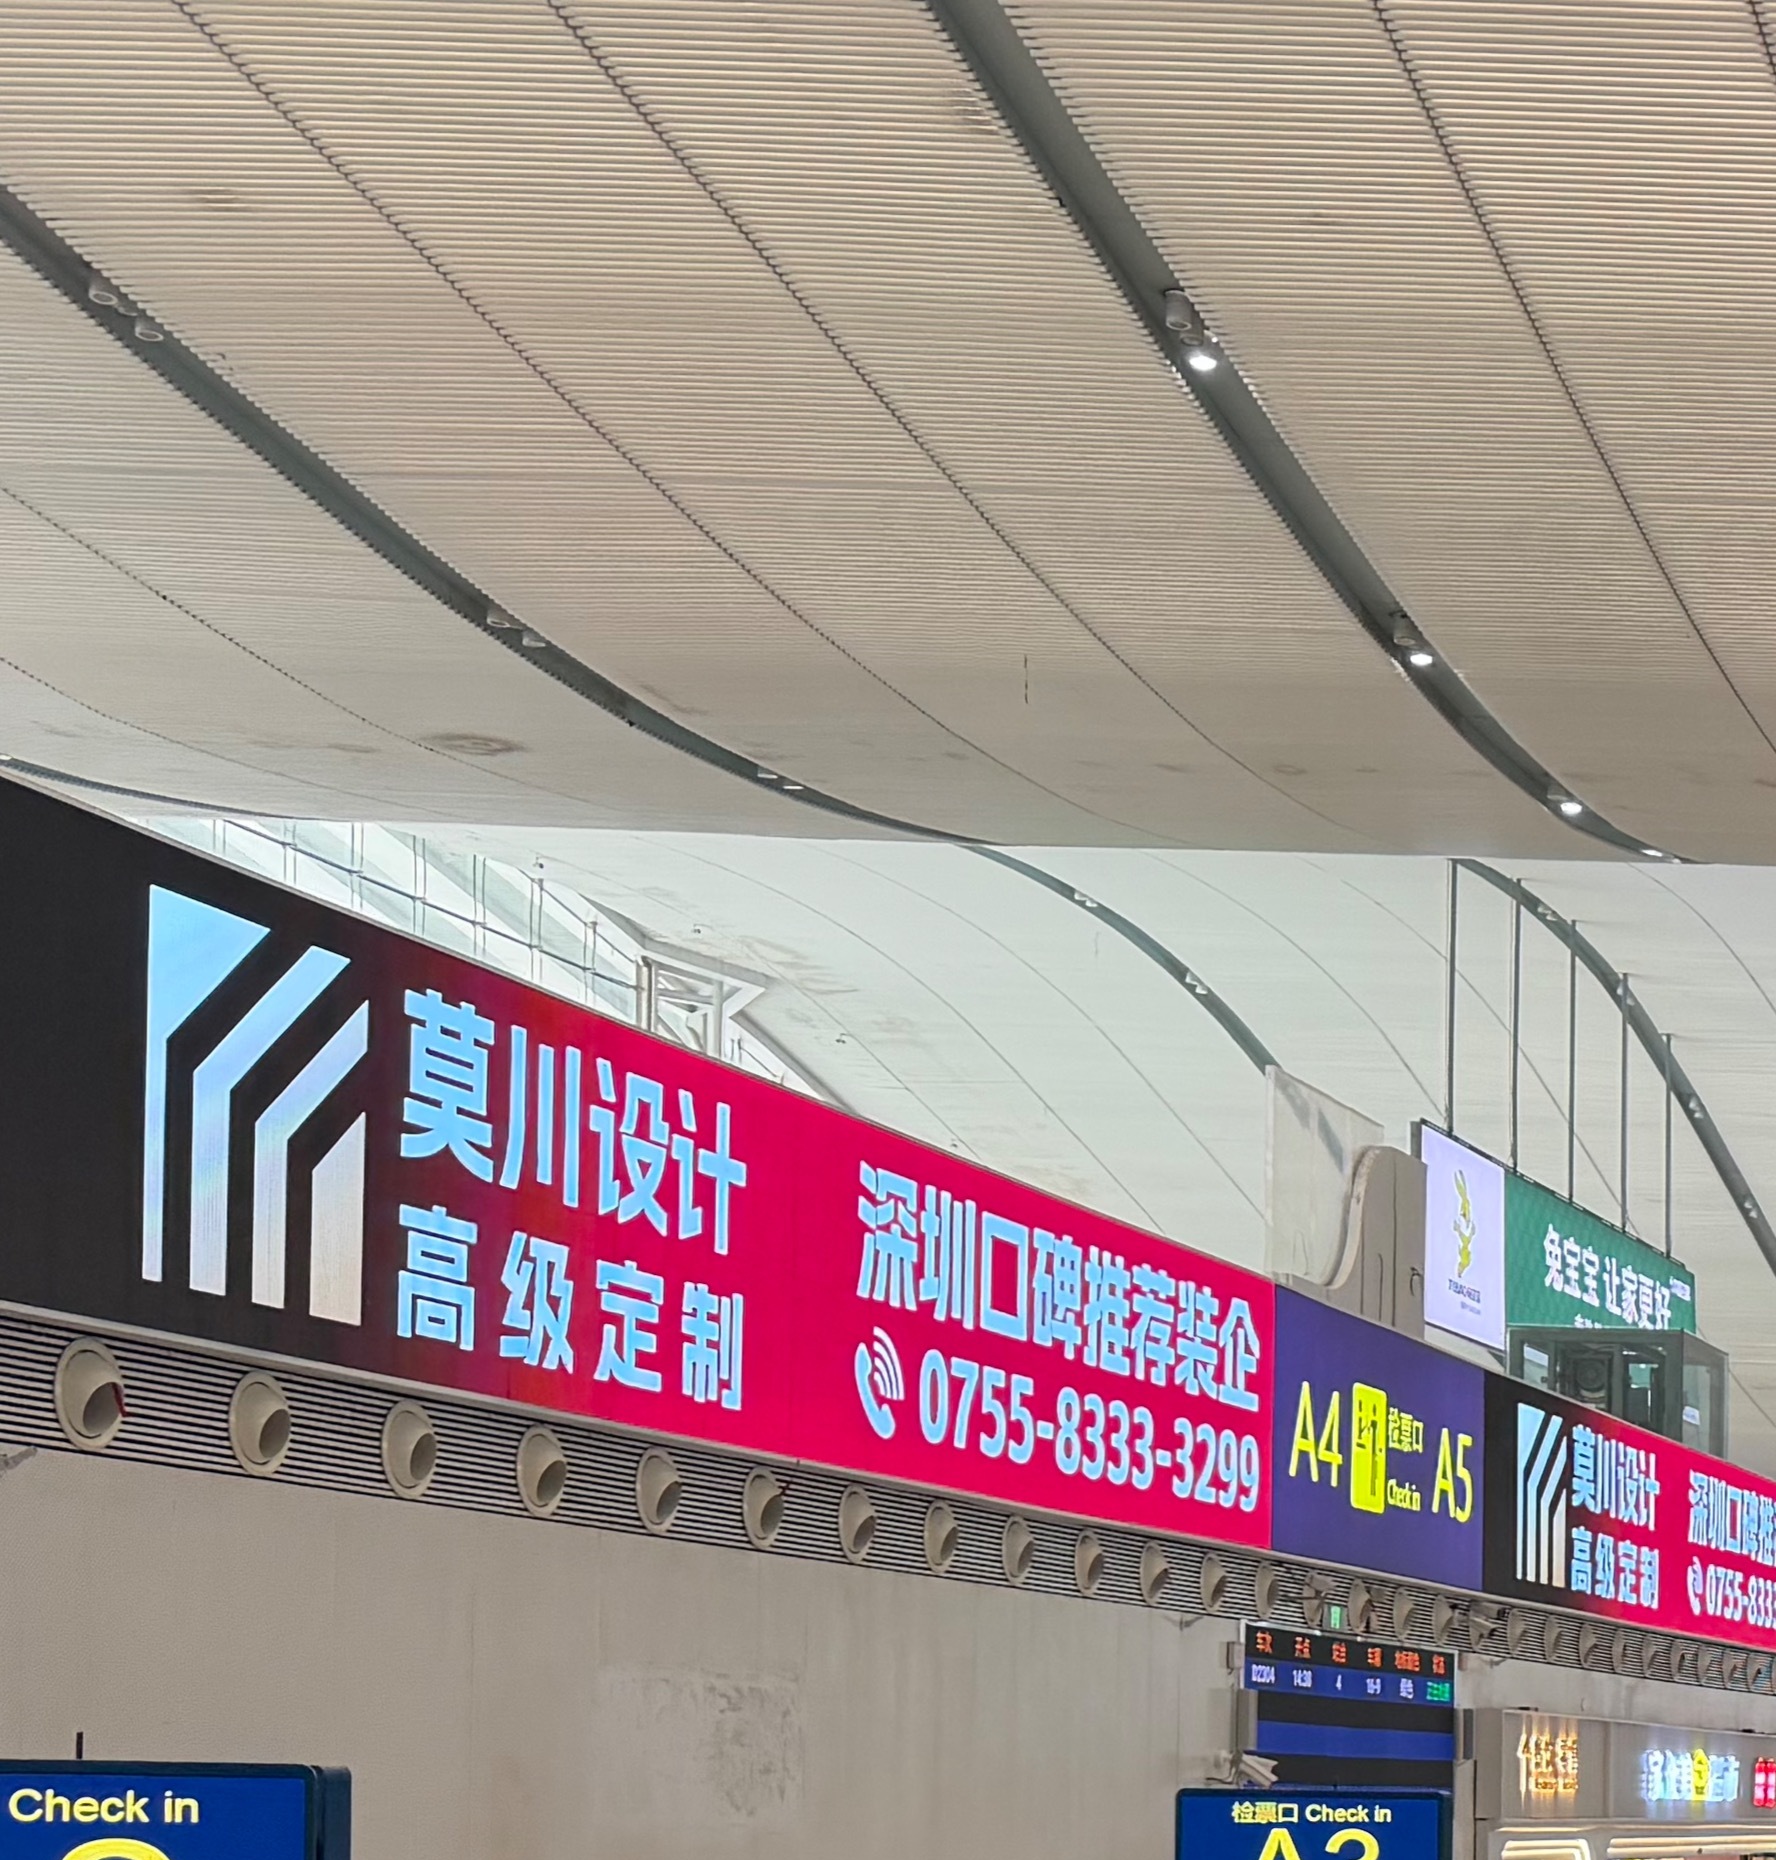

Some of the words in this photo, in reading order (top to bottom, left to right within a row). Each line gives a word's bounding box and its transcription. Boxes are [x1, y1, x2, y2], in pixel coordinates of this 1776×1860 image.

[399, 988, 747, 1256] 莫川设计
[397, 1206, 744, 1411] 高级定制
[857, 1159, 1261, 1412] 深圳口碑推荐装企
[1543, 1223, 1600, 1307] 兔宝宝
[918, 1348, 1260, 1513] 0755-8333-3299
[1289, 1381, 1343, 1487] A4
[1388, 1406, 1424, 1453] 检票口
[1387, 1478, 1410, 1509] Check
[1432, 1427, 1474, 1523] A5
[1571, 1424, 1660, 1531] 莫川设计
[1571, 1526, 1660, 1610] 高级定制
[1335, 1674, 1343, 1692] 4
[10, 1788, 149, 1823] Check
[165, 1790, 199, 1823] in
[1232, 1801, 1299, 1824] 检票口
[1304, 1801, 1369, 1824] Check
[1373, 1802, 1392, 1823] in
